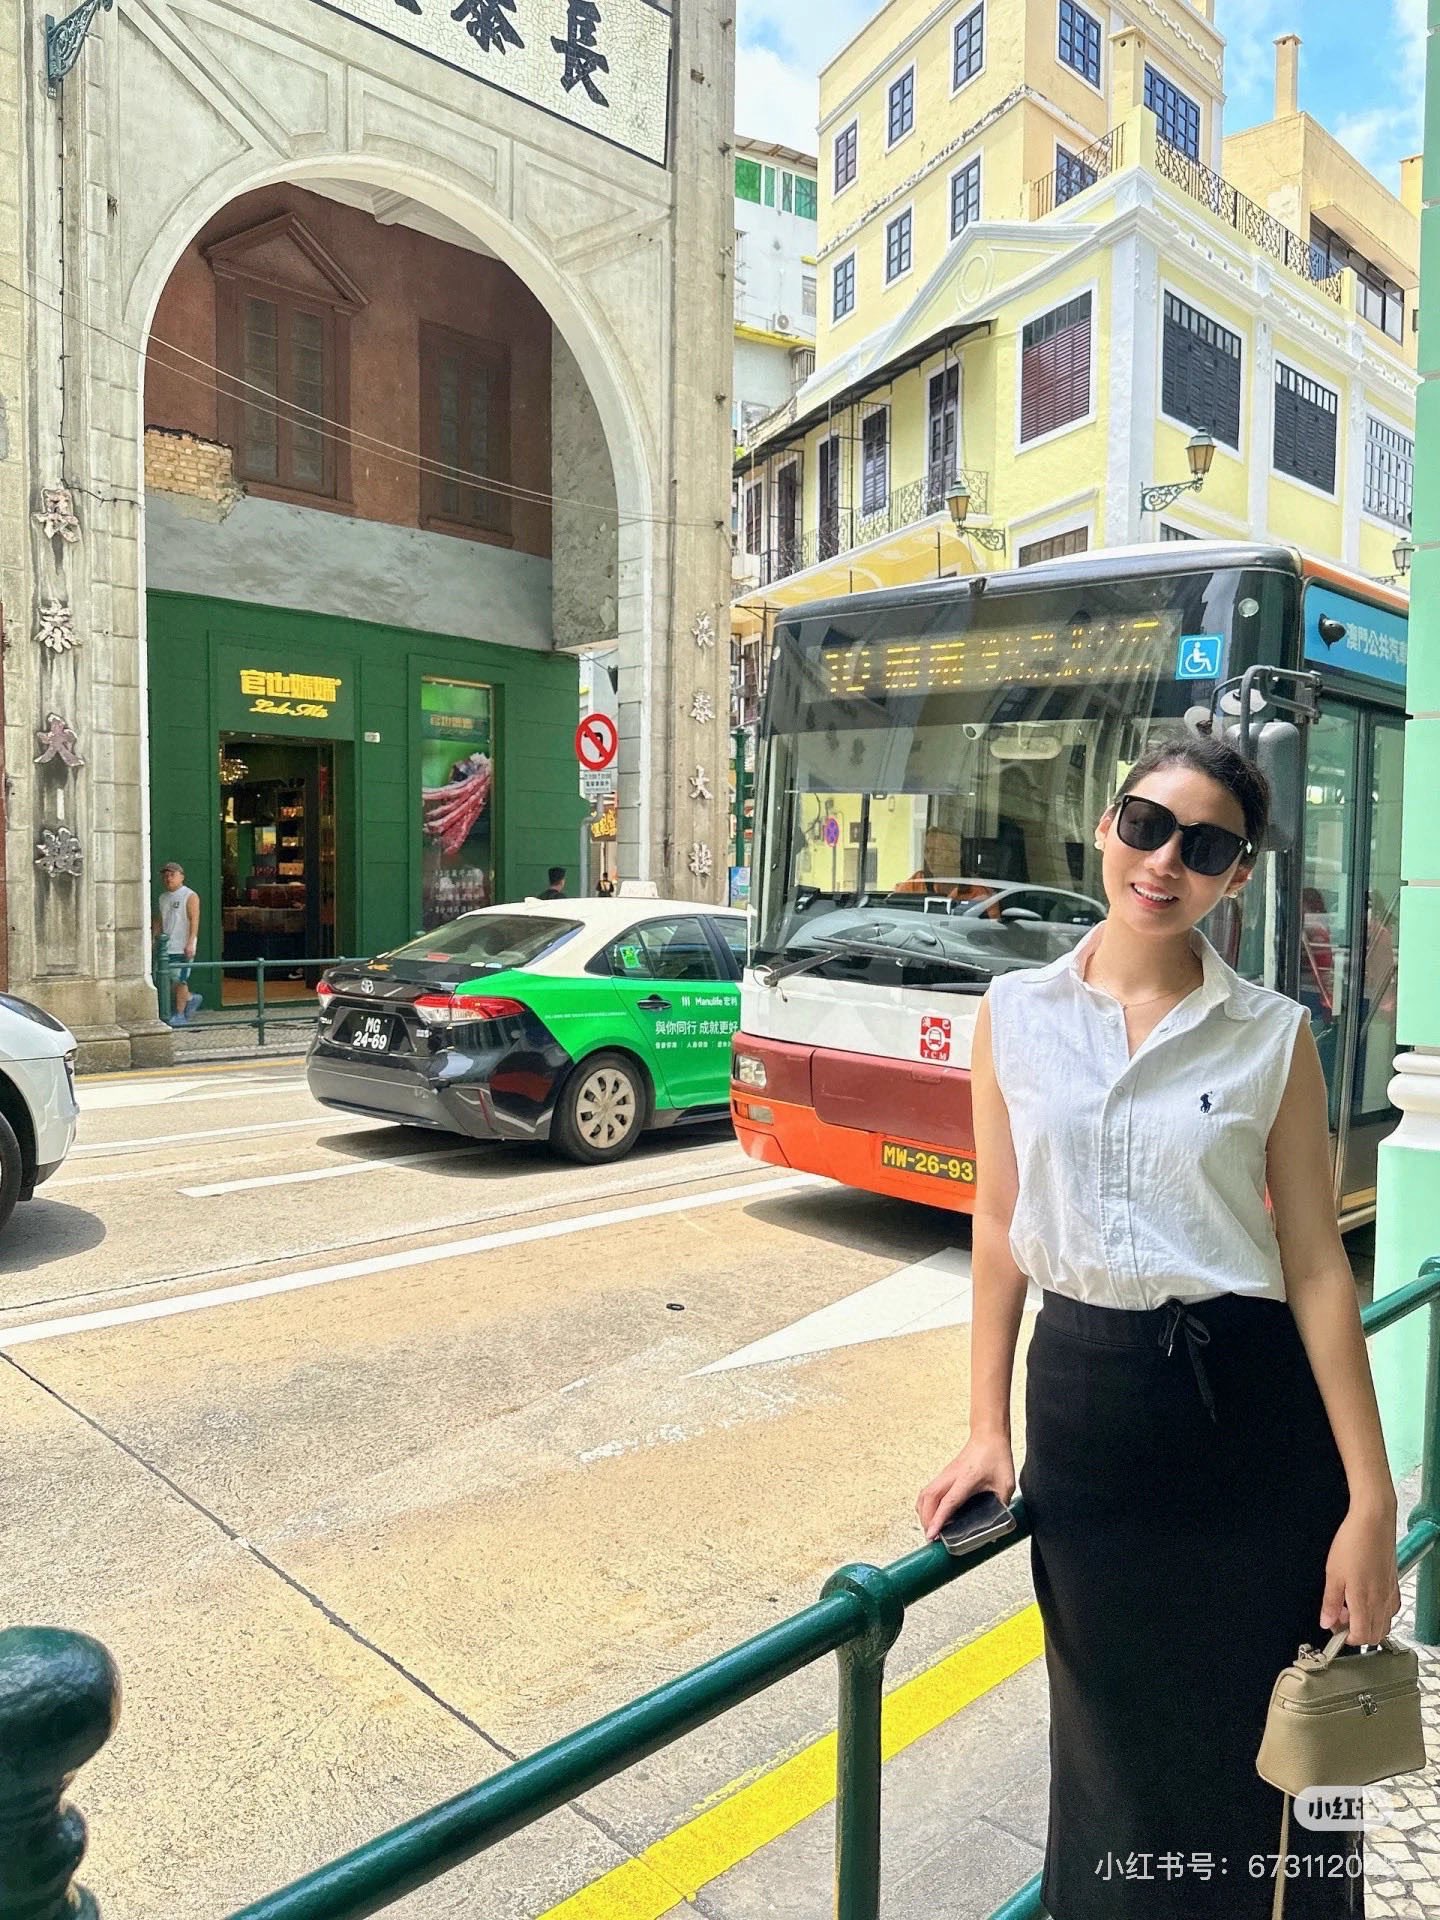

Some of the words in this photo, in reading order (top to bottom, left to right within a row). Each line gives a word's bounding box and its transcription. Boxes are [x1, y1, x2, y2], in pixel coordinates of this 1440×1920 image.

[695, 996, 722, 1006] Manulife
[365, 1017, 381, 1033] MG
[655, 1020, 696, 1035] 與你同行
[699, 1020, 738, 1035] 成就更好
[353, 1031, 387, 1049] 24-69
[922, 1049, 947, 1061] TCM
[884, 1145, 974, 1181] MW-26-93
